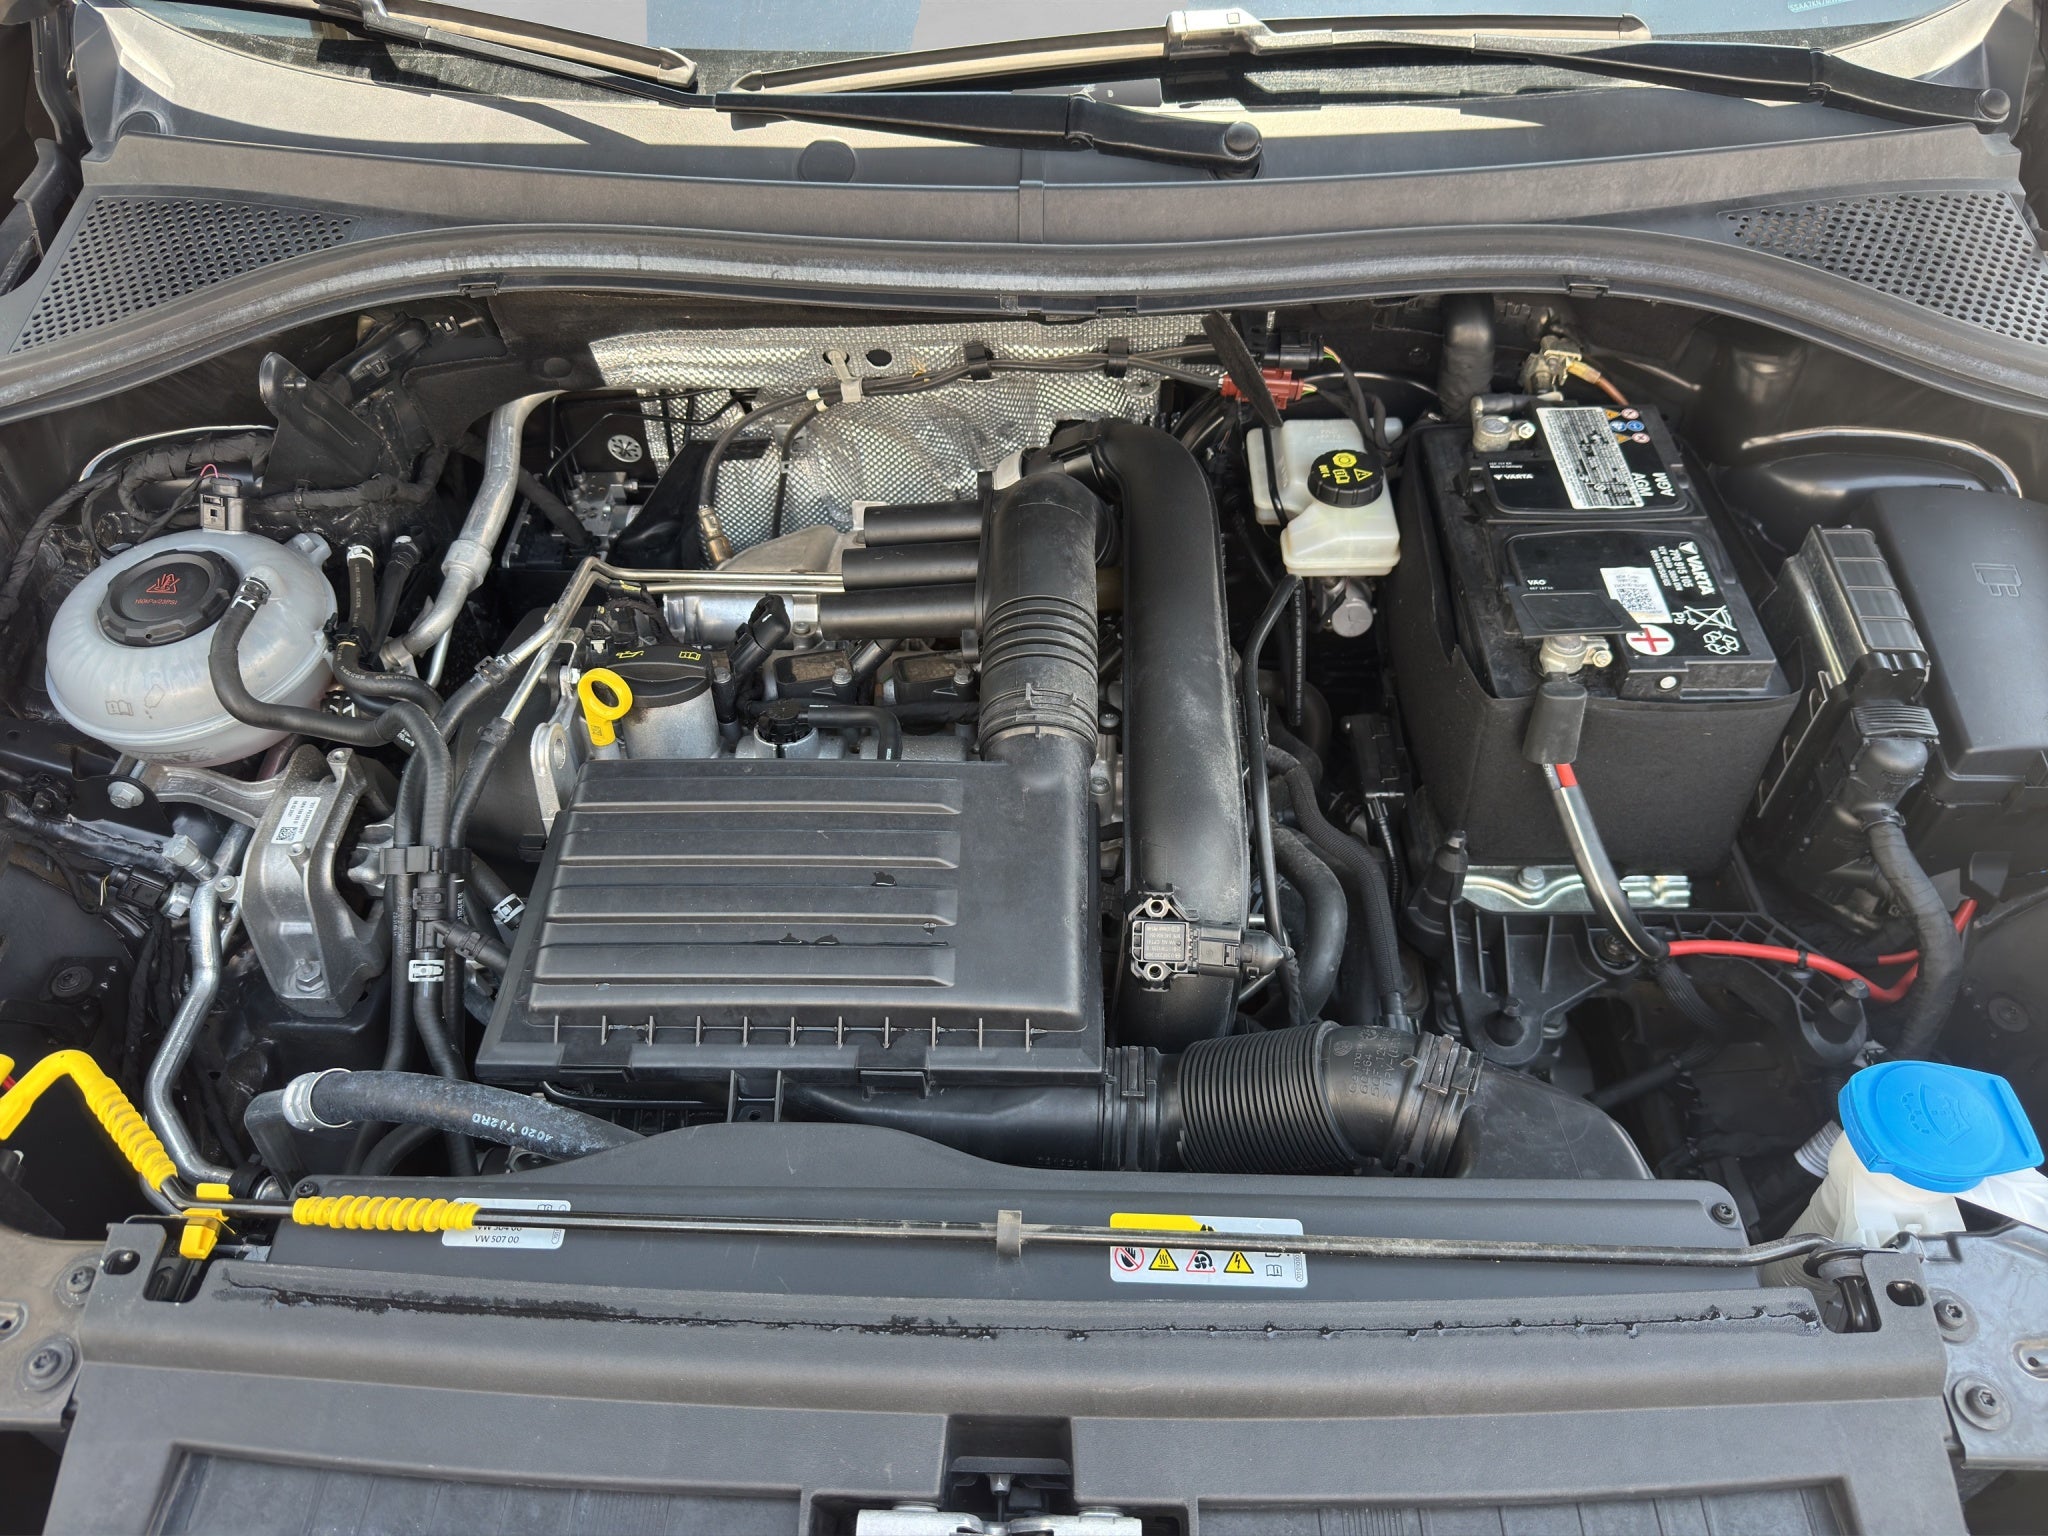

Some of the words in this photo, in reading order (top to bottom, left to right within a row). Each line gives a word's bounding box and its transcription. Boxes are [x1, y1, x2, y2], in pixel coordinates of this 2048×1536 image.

[1631, 472, 1655, 497] AGM
[1651, 472, 1676, 497] AGM
[1673, 561, 1688, 574] 915
[1679, 575, 1694, 588] 105
[1686, 554, 1716, 596] VARTA
[1671, 612, 1687, 625] Pb
[474, 1235, 490, 1243] VW
[490, 1235, 507, 1243] 507
[507, 1235, 520, 1244] 00
